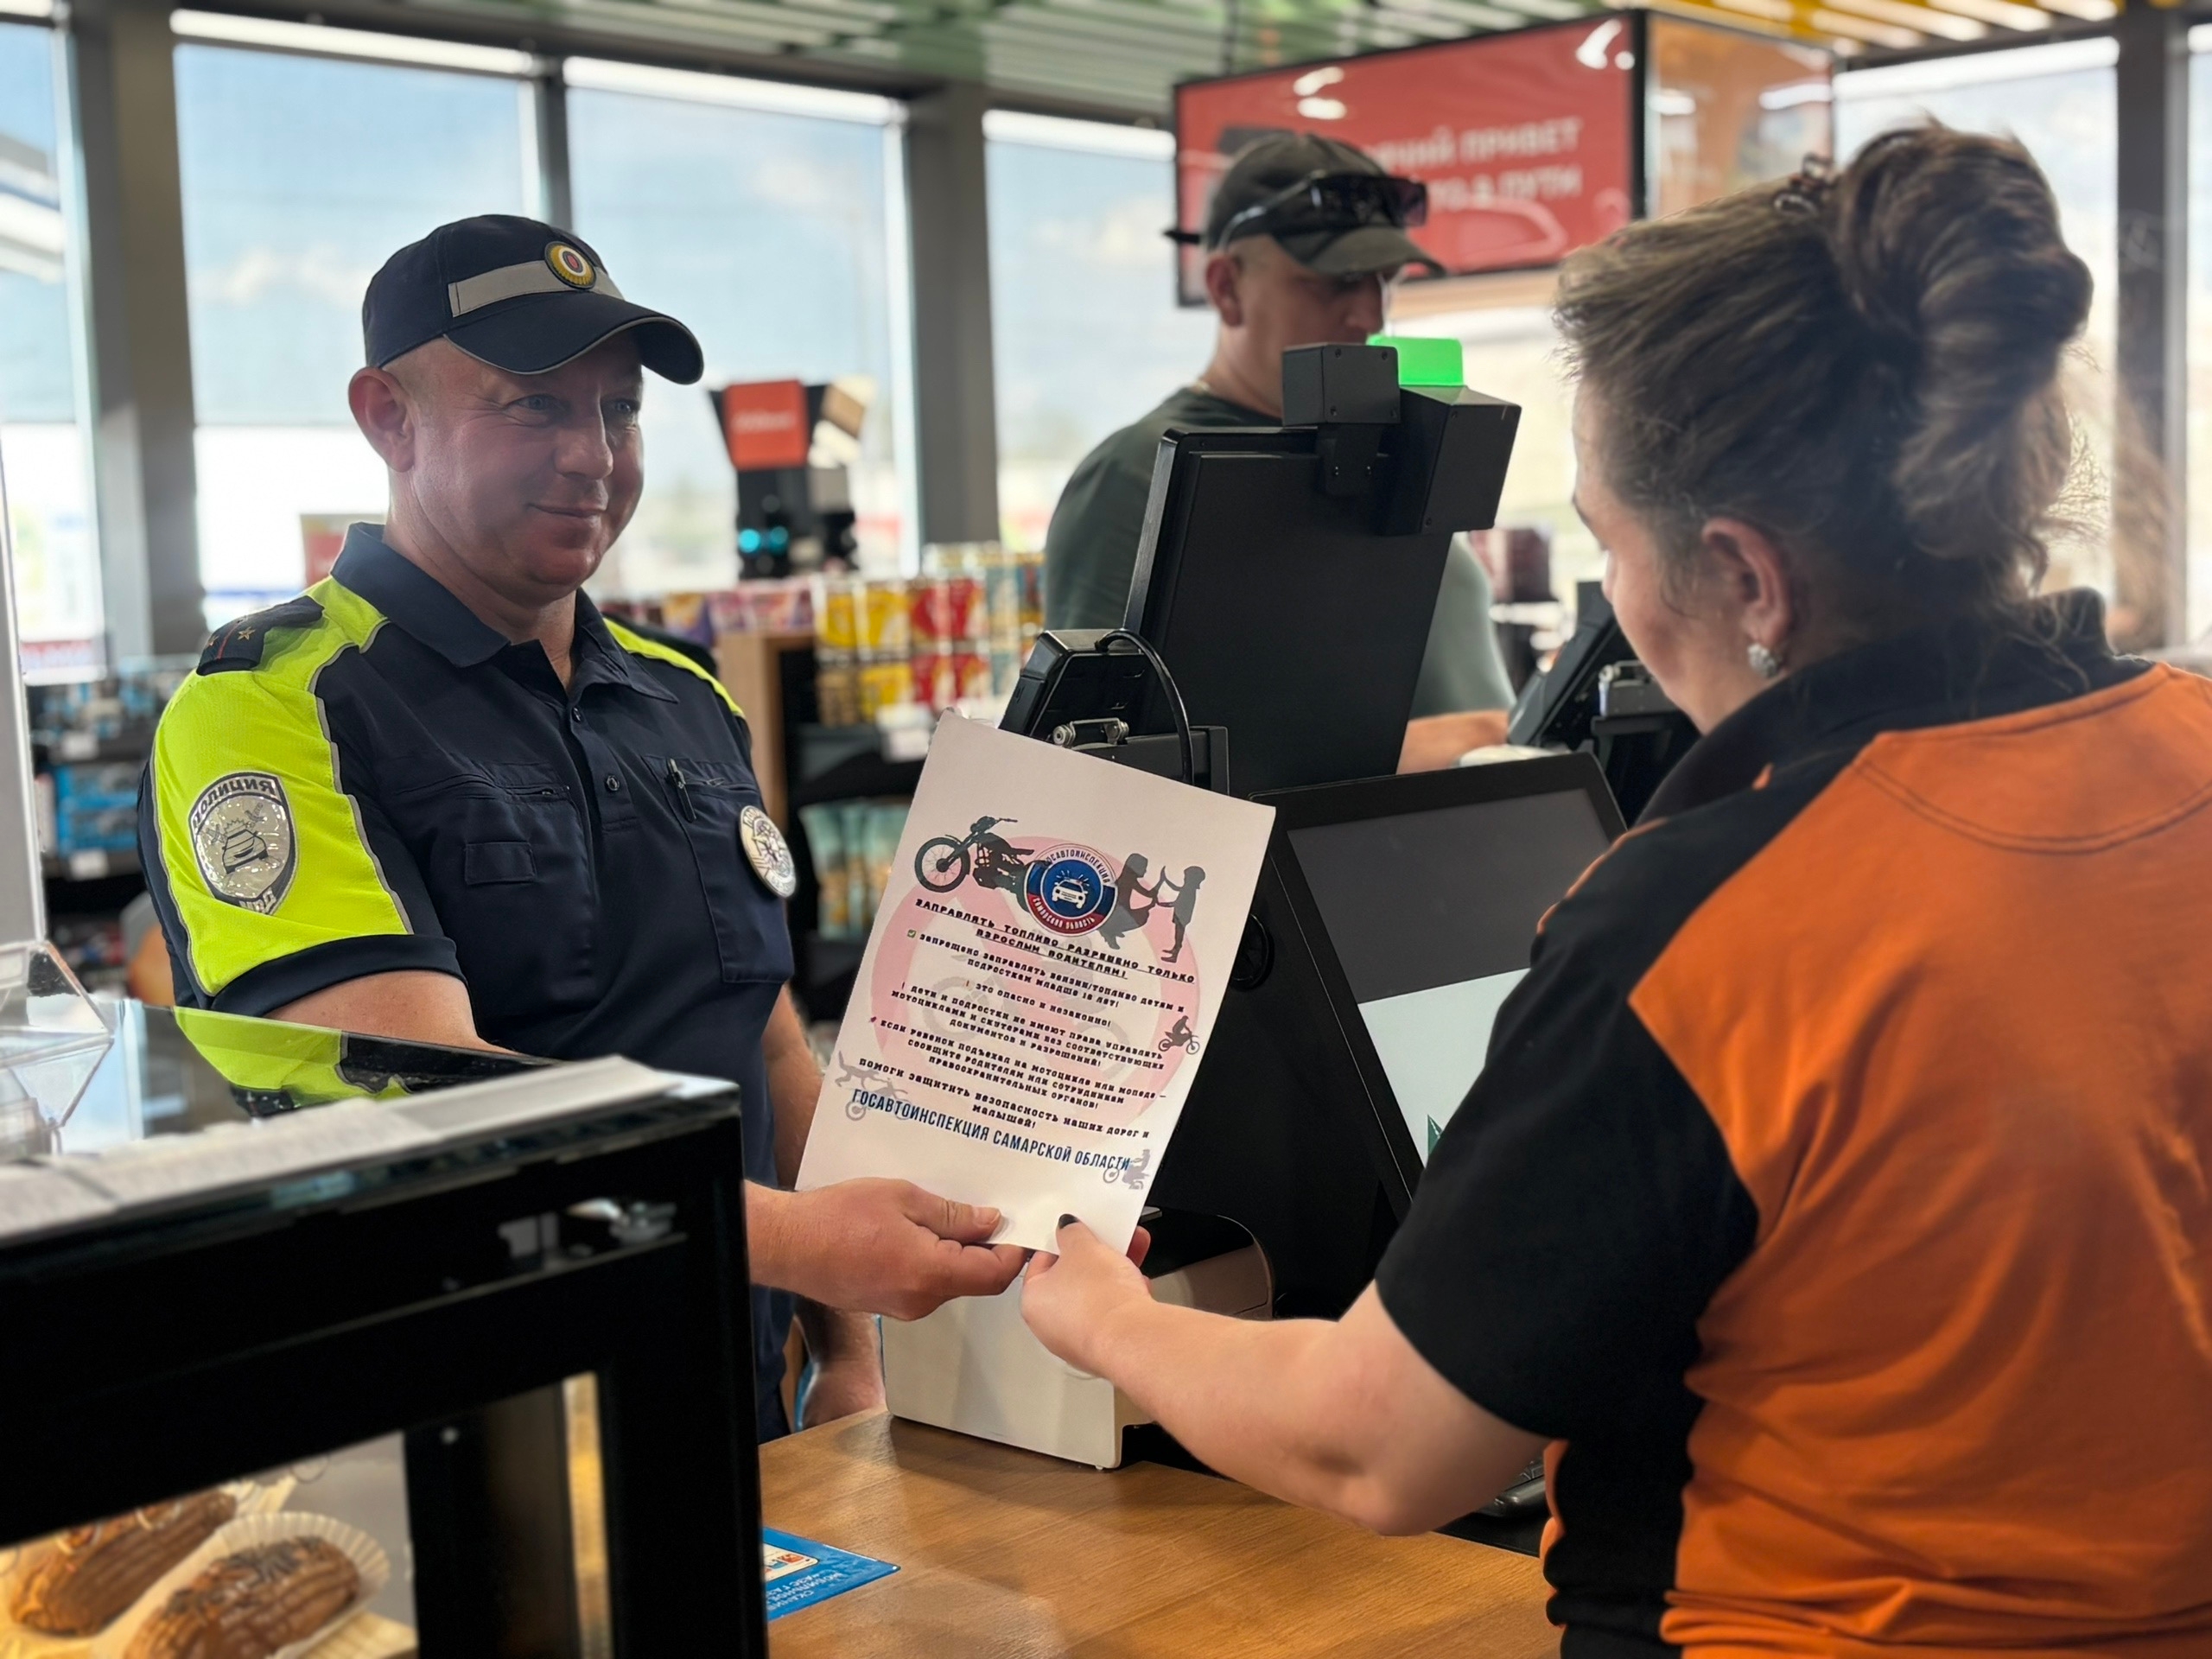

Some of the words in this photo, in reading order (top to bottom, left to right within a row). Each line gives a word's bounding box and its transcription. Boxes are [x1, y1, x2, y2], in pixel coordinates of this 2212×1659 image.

[1459, 115, 1583, 163] ПРИВЕТ
[192, 777, 276, 830] ПОЛИЦИЯ
[915, 899, 995, 928] ЗАПРАВЛЯТЬ
[1004, 925, 1058, 947] ТОПЛИВО
[1068, 944, 1139, 969] РАЗРЕШЕНО
[1148, 965, 1195, 984] ТОЛЬКО
[976, 928, 1040, 953] ВЗРОСЛЫМ
[1048, 950, 1127, 979] ВОДИТЕЛЯМ!
[852, 1088, 989, 1141] ГОСАВТОИНСПЕКЦИЯ
[993, 1129, 1071, 1162] САМАРСКОЙ
[1074, 1150, 1130, 1171] ОБЛАСТИ
